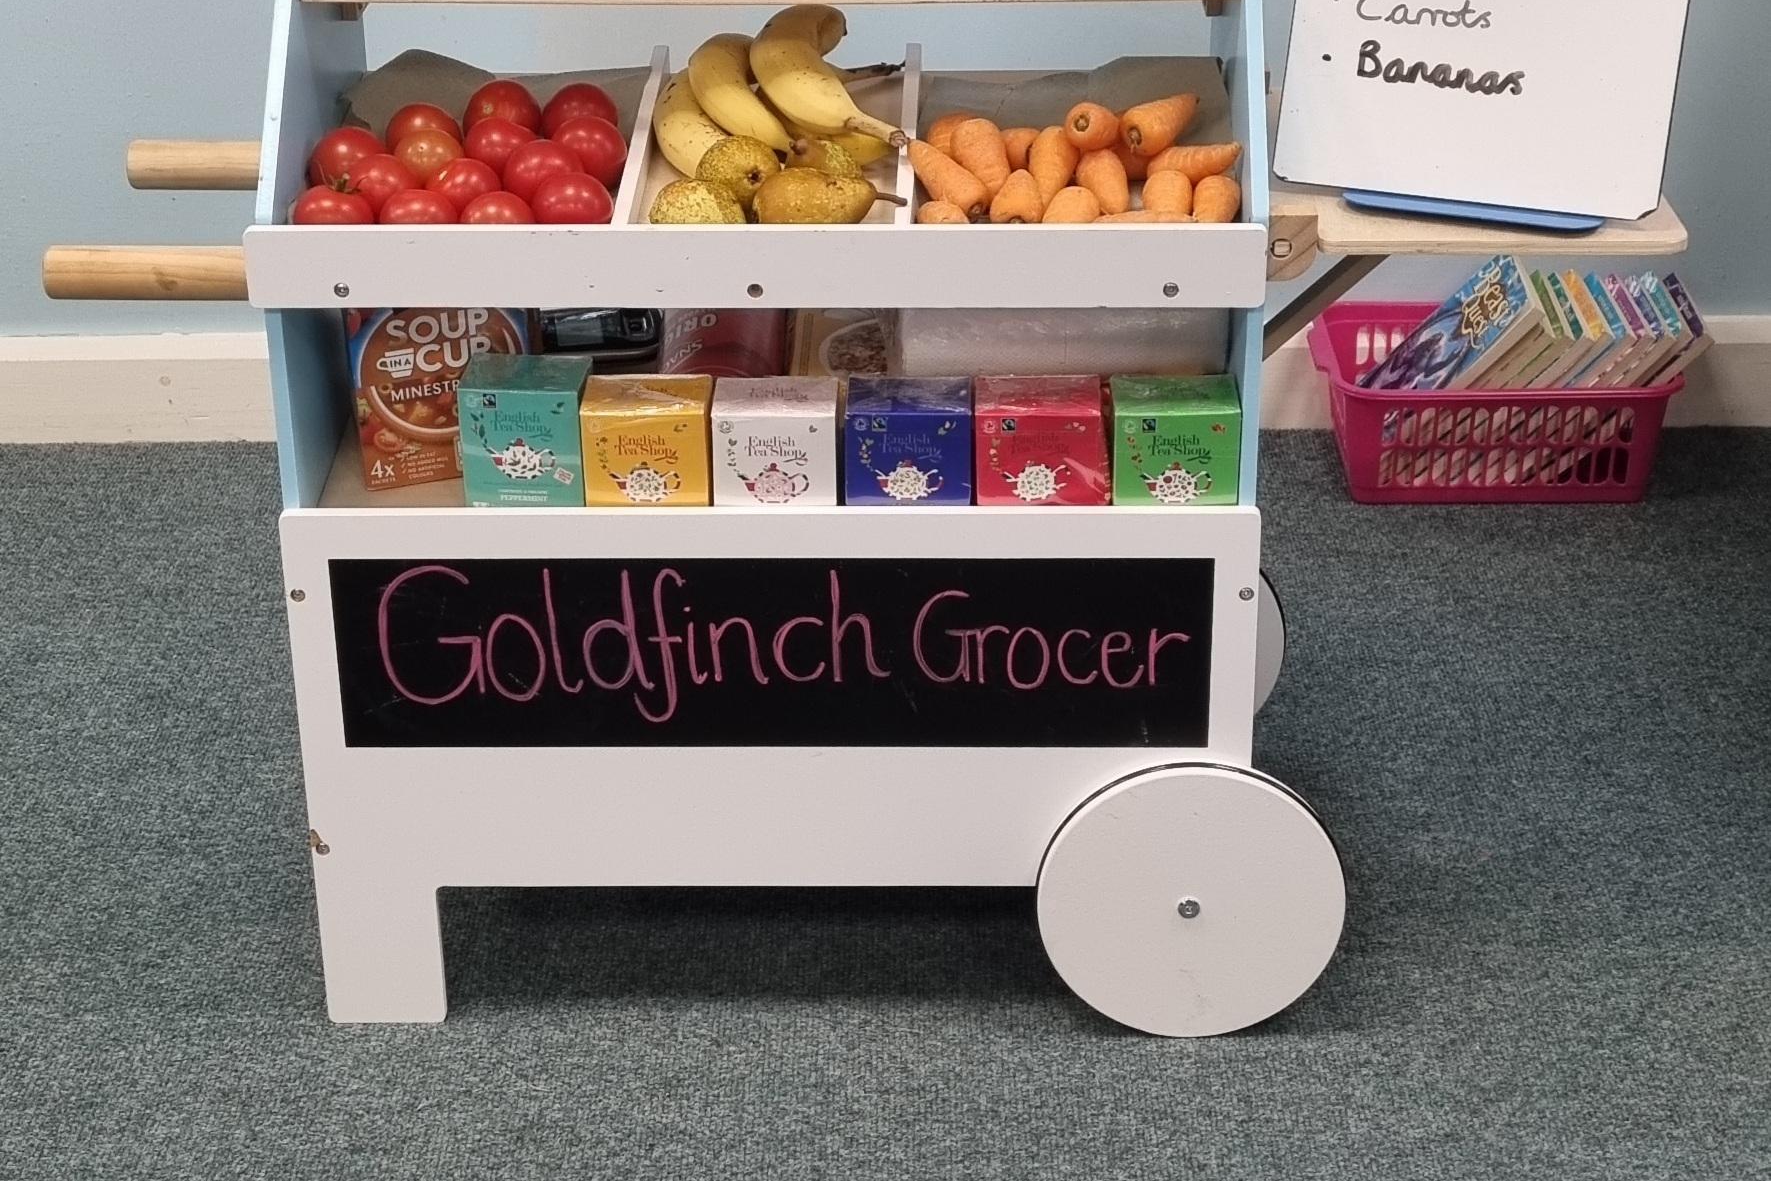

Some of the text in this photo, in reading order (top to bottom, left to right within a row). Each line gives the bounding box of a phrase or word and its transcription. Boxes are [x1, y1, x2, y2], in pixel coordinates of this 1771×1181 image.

[1356, 39, 1525, 95] Bananas
[1474, 265, 1511, 326] Beast
[386, 308, 489, 344] SOUP
[1462, 294, 1489, 350] Quest
[404, 358, 412, 366] A
[415, 336, 491, 373] CUP
[391, 380, 460, 402] MINESTR
[493, 410, 541, 425] English
[515, 420, 547, 437] Shop
[618, 435, 666, 448] English
[748, 436, 796, 449] English
[882, 434, 931, 448] English
[1151, 435, 1200, 448] English
[614, 444, 673, 460] Tea Shop
[744, 444, 802, 461] Tea Shop
[904, 442, 937, 458] Shop
[1147, 443, 1206, 459] Tea Shop
[371, 460, 395, 478] 4x
[378, 565, 1192, 722] Goldfinch Grocer
